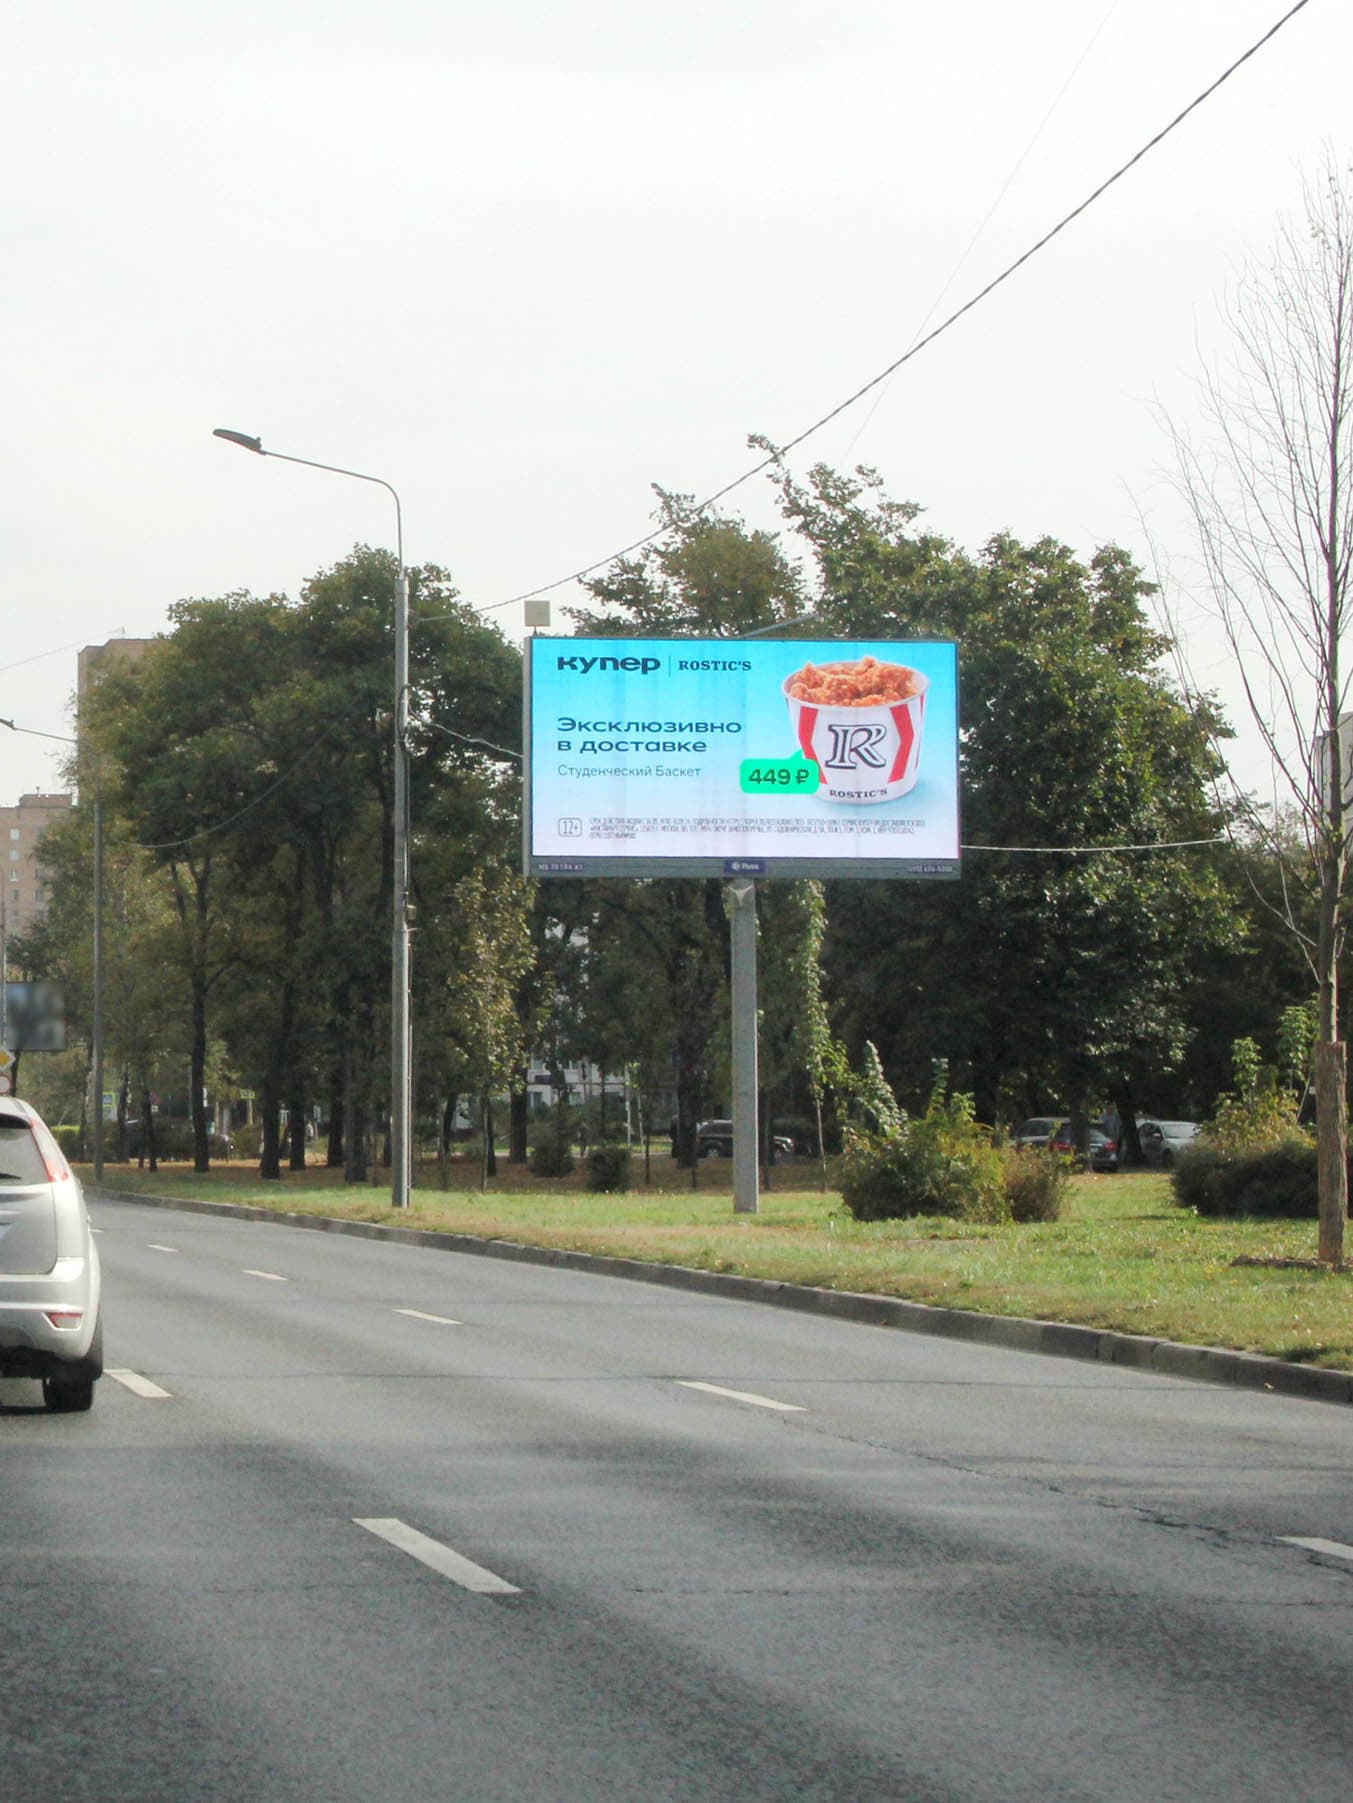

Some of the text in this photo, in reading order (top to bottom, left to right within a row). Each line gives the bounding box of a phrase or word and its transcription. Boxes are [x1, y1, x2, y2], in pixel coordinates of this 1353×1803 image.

[557, 656, 661, 675] купер
[678, 660, 752, 672] ROSTIC'S
[557, 717, 742, 733] Эксклюзивно
[557, 740, 707, 754] в доставке
[557, 764, 701, 779] Студенческий Баскет
[749, 769, 791, 785] 449
[829, 788, 888, 799] ROSTIC'S
